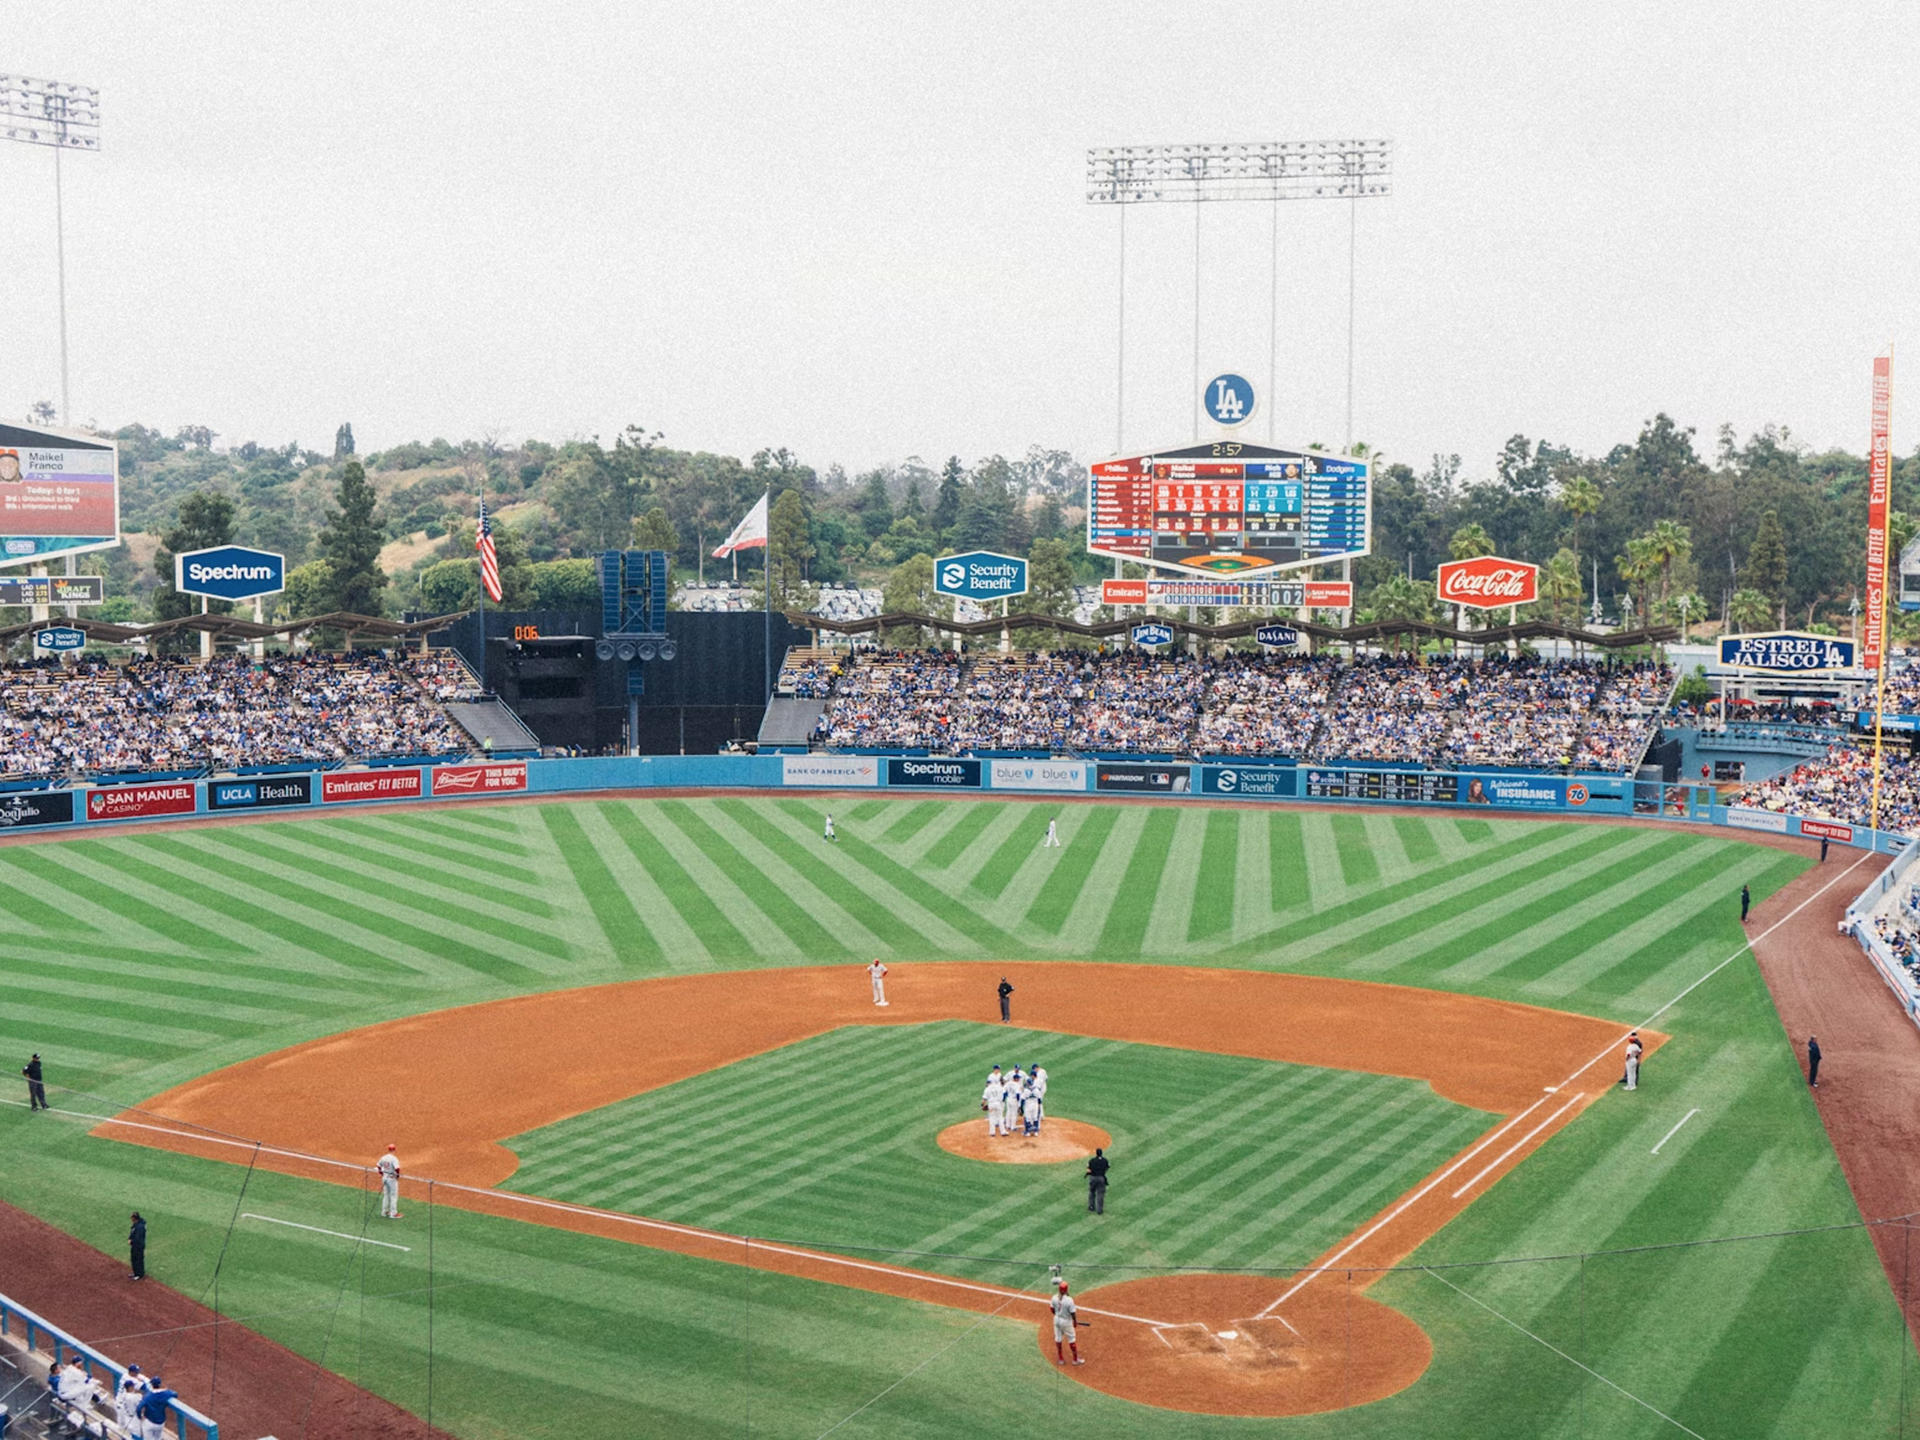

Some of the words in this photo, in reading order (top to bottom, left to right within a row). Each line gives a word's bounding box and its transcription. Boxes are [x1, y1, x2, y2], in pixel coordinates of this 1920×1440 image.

[1215, 380, 1243, 419] LA
[1873, 375, 1889, 412] BETTER
[1872, 413, 1888, 433] FLY
[1212, 443, 1242, 456] 2:57
[29, 452, 64, 461] Maikel
[29, 461, 64, 470] Franco
[1325, 465, 1355, 474] Dodgers
[1869, 437, 1888, 504] Emirates
[1867, 528, 1884, 564] BETTER
[189, 564, 271, 583] Spectrum
[969, 563, 1019, 579] Security
[1867, 565, 1883, 583] FLY
[970, 577, 1012, 589] Benefit
[1445, 568, 1529, 596] Coca-Cola
[1106, 588, 1144, 597] Emirates
[1271, 590, 1280, 604] 0
[1283, 590, 1291, 604] 0
[1294, 590, 1302, 604] 2
[1864, 588, 1881, 656] Emirates
[55, 632, 81, 641] Security
[515, 625, 538, 640] 0:06
[1259, 631, 1295, 642] DASANI
[1729, 652, 1819, 668] JALISCO
[1840, 713, 1856, 722] 2:57
[484, 769, 502, 777] THIS
[903, 761, 962, 776] Spectrum
[997, 768, 1022, 778] blue
[1042, 768, 1068, 779] blue
[485, 778, 500, 787] FOR
[1240, 771, 1280, 783] Security
[325, 779, 375, 794] Emirates
[378, 778, 391, 790] FLY
[392, 776, 418, 789] BETTER
[1240, 782, 1276, 793] Benefit
[106, 792, 134, 804] SAN
[137, 788, 191, 801] MANUEL
[221, 789, 252, 800] UCLA
[259, 784, 303, 799] Health
[1496, 788, 1556, 800] INSURANCE
[1570, 789, 1585, 800] 76
[106, 804, 143, 813] CASINO
